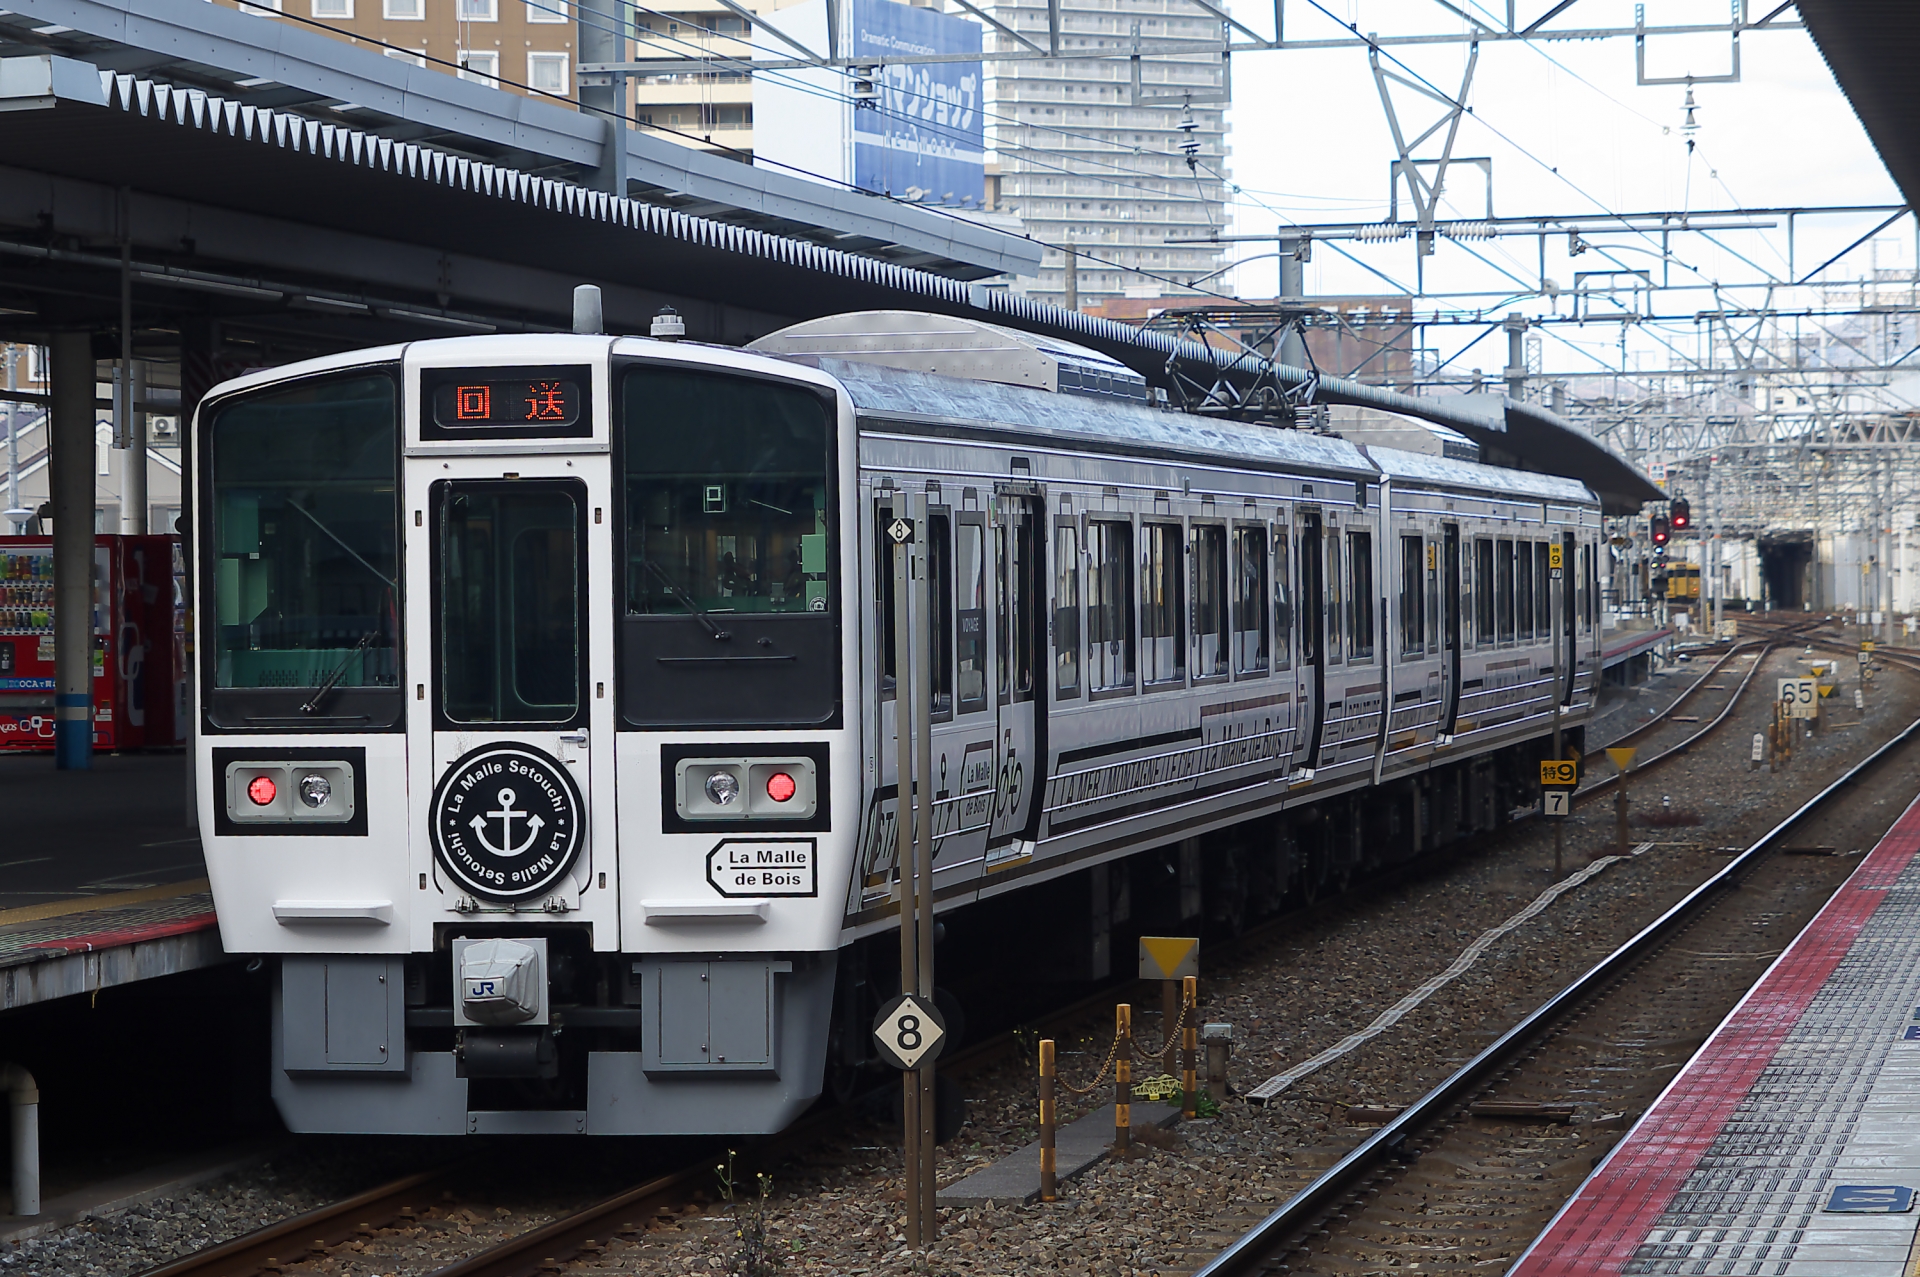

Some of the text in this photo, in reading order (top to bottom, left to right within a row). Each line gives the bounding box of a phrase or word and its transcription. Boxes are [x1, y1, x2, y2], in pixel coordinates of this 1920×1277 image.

[861, 28, 936, 55] Dramatic Communication
[457, 381, 565, 421] 回送
[895, 523, 903, 539] 8
[1782, 682, 1813, 704] 65
[967, 761, 990, 784] La Malle
[447, 759, 567, 813] La Malle Setouchi
[1550, 794, 1563, 812] 7
[447, 832, 567, 885] La Malle Setouchi
[729, 849, 807, 864] La Malle
[735, 872, 801, 886] de Bois
[472, 982, 495, 996] JR
[896, 1014, 922, 1051] 8
